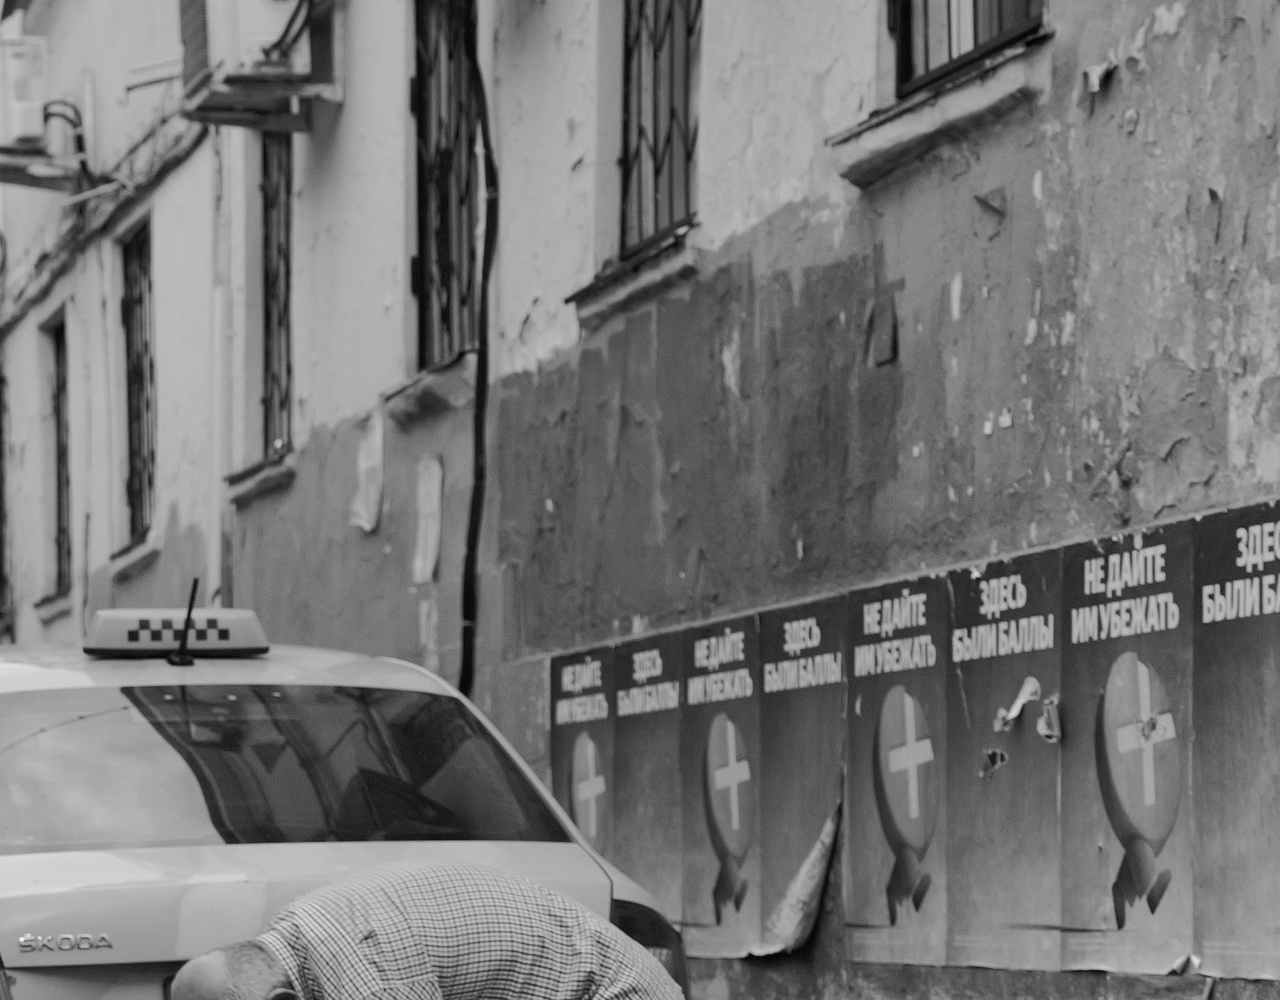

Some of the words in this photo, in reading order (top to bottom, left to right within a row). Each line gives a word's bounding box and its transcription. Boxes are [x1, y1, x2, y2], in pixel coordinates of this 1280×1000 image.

[1084, 557, 1106, 595] НЕ
[1106, 541, 1167, 598] ДАЙТЕ
[863, 602, 881, 635] НЕ
[881, 588, 927, 638] ДАЙТЕ
[979, 574, 1027, 619] ЗДЕСЬ
[1071, 605, 1099, 645] ИМ
[1099, 592, 1180, 640] УБЕЖАТЬ
[1202, 576, 1260, 624] БЫЛИ
[783, 616, 821, 657] ЗДЕСЬ
[854, 643, 875, 678] ИМ
[875, 634, 937, 675] УБЕЖАТЬ
[952, 623, 997, 663] БЫЛИ
[998, 613, 1054, 656] БАЛЛЫ
[764, 659, 798, 694] БЫЛИ
[798, 651, 842, 689] БАЛЛЫ
